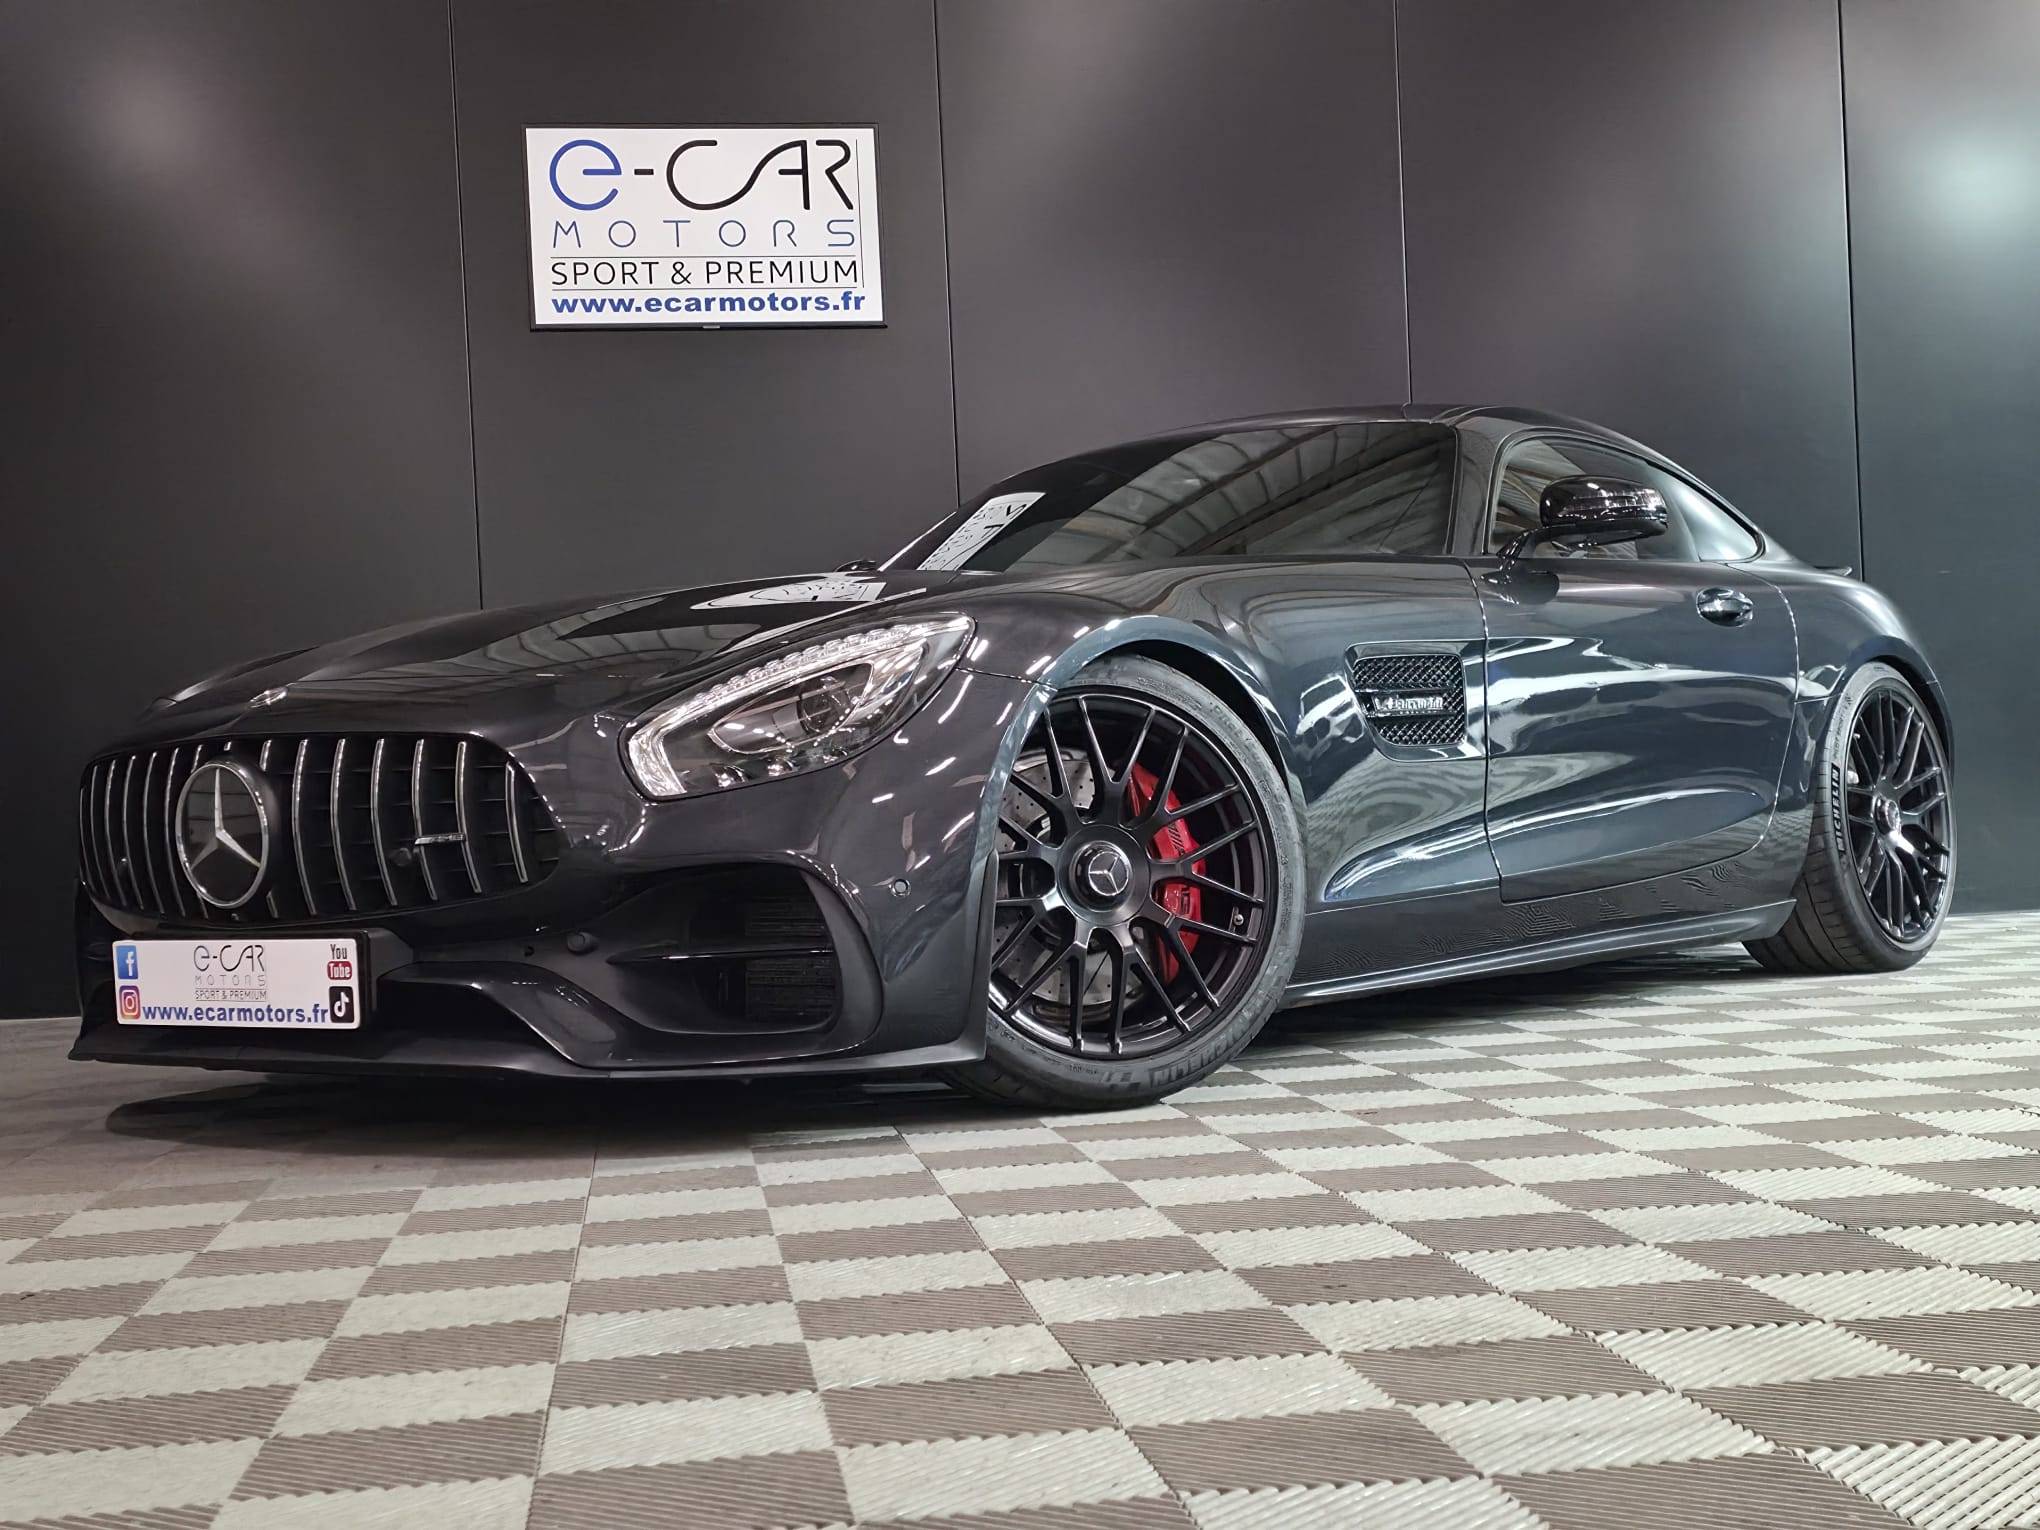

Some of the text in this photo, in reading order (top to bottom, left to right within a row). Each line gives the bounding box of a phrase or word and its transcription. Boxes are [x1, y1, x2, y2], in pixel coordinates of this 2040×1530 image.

[553, 219, 855, 248] MOTORS
[551, 259, 858, 285] SPORT & PREMIUM
[551, 290, 865, 313] www.ecarmotors.fr
[1831, 767, 1846, 851] MICHELIN
[330, 944, 348, 960] You
[329, 963, 352, 979] Tube
[195, 990, 267, 1000] SPORT & PREMIUM
[142, 1003, 328, 1023] www.ecarmotors.fr
